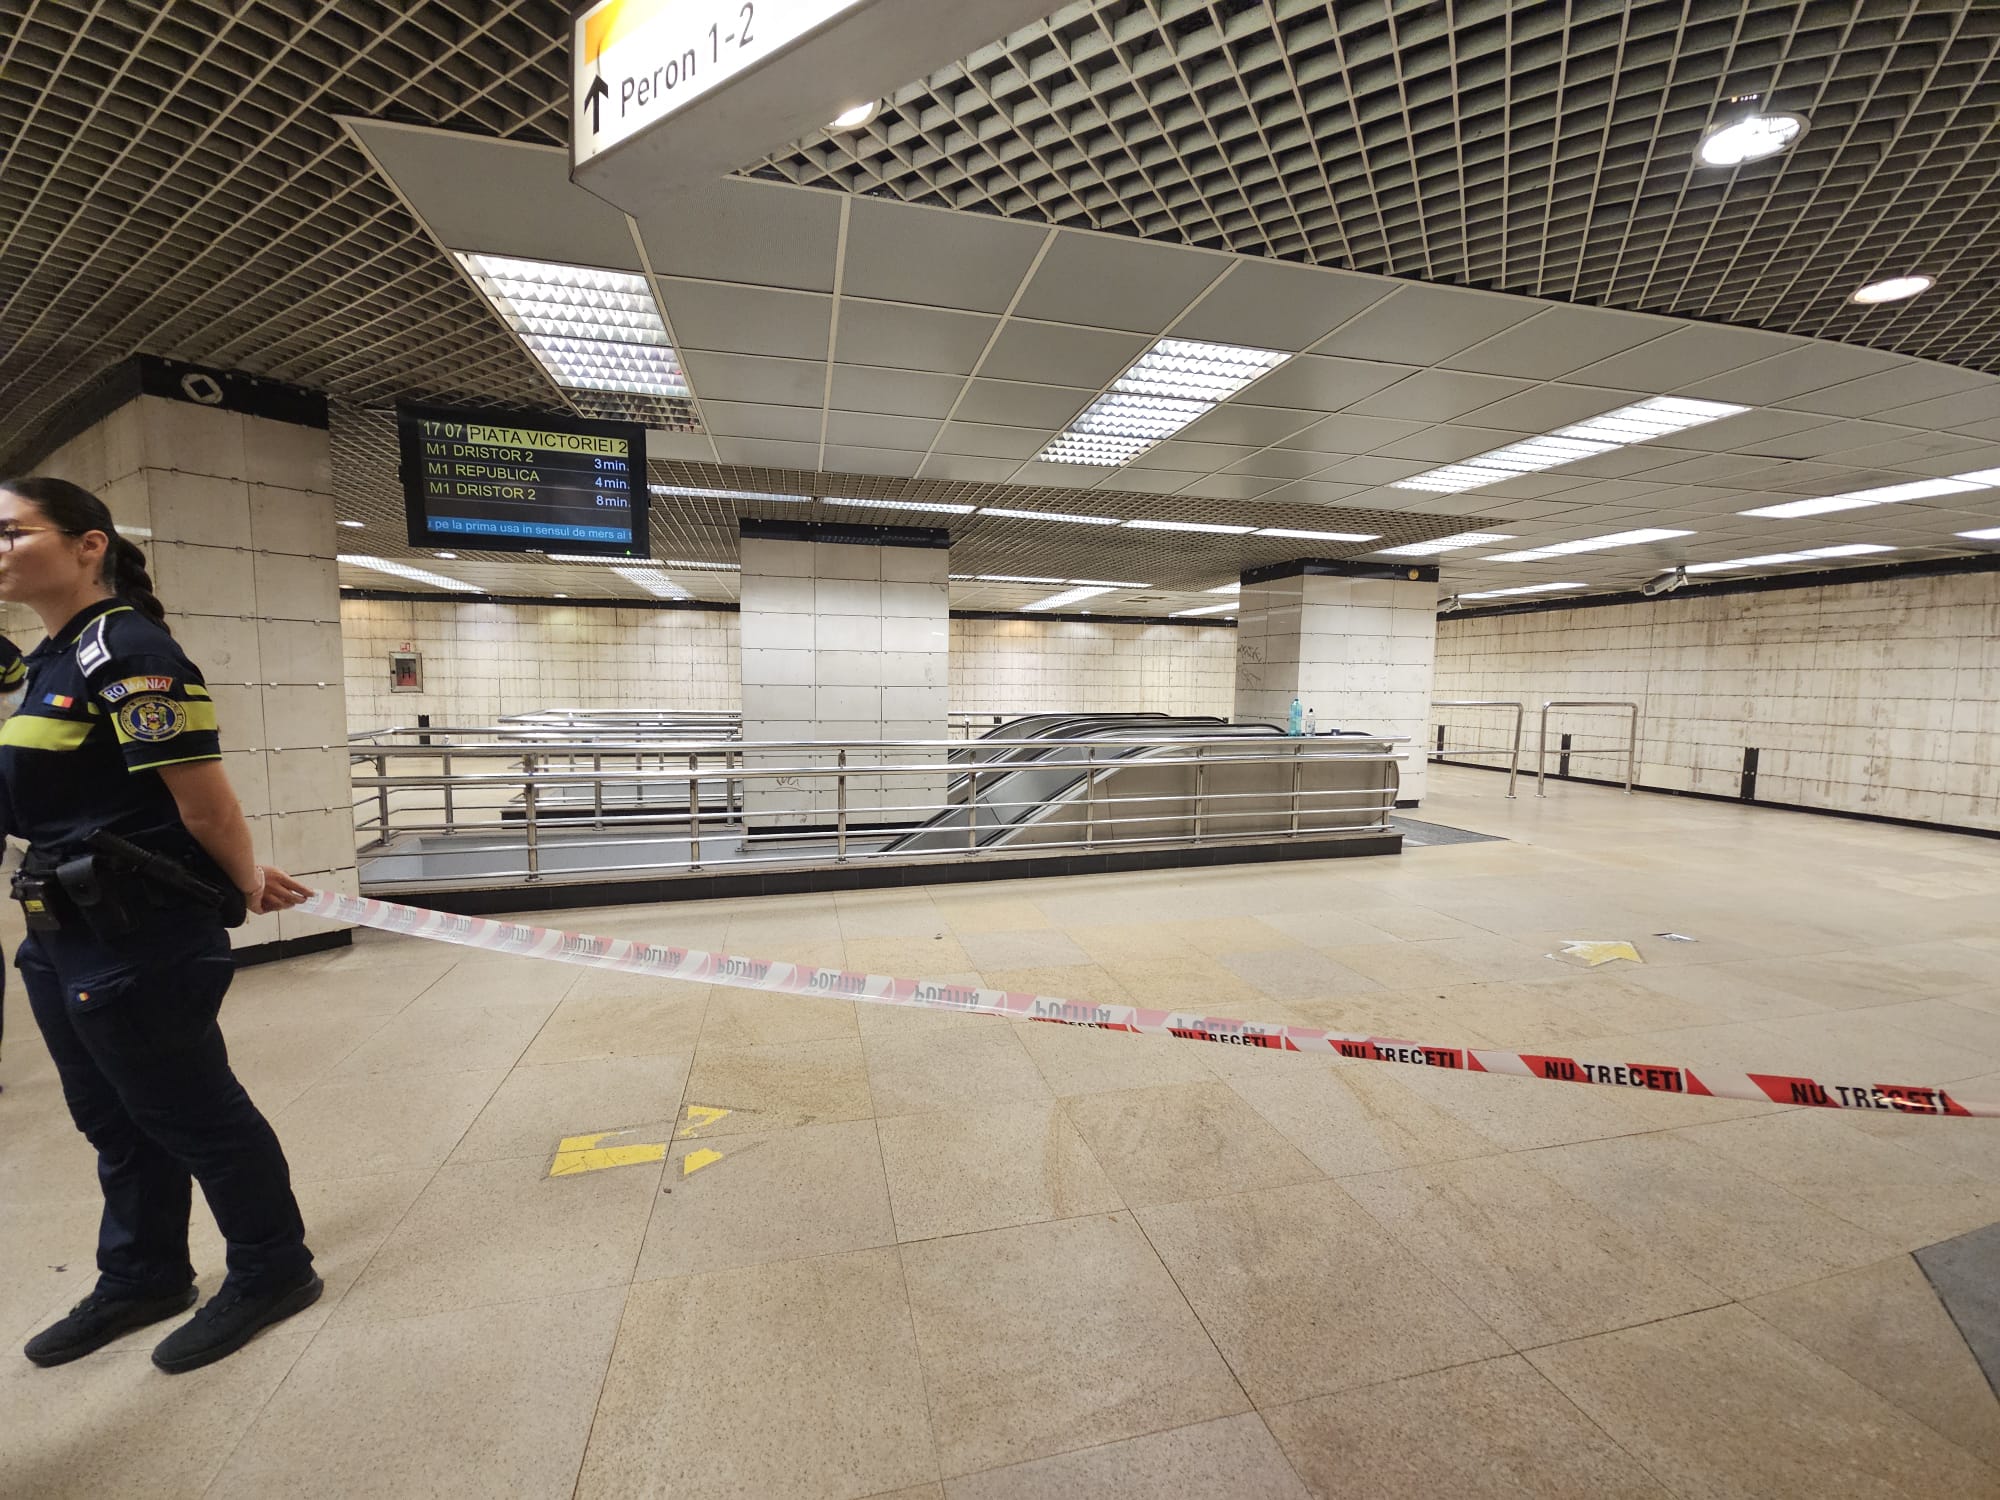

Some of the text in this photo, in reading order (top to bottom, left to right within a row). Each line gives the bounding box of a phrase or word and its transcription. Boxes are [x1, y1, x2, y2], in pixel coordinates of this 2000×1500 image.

[621, 2, 754, 117] Peron 1-2
[424, 421, 462, 438] 17 07
[470, 426, 628, 453] PIATA VICTORIEI 2
[426, 443, 534, 462] M1 DRISTOR 2
[428, 462, 540, 482] M1 REPUBLICA
[594, 458, 602, 469] 3
[430, 481, 536, 500] M1 DRISTOR 2
[595, 476, 602, 488] 4
[596, 495, 604, 505] 8
[435, 521, 449, 530] pe
[452, 520, 462, 529] la
[466, 522, 497, 532] prima
[500, 525, 519, 533] usa
[523, 525, 532, 533] in
[536, 527, 570, 536] sensul
[572, 528, 585, 537] de
[588, 530, 614, 539] mers
[1373, 1046, 1455, 1068] TRECETI
[1543, 1060, 1684, 1091] NU TRECETI
[1790, 1082, 1951, 1113] NU TRECETI
